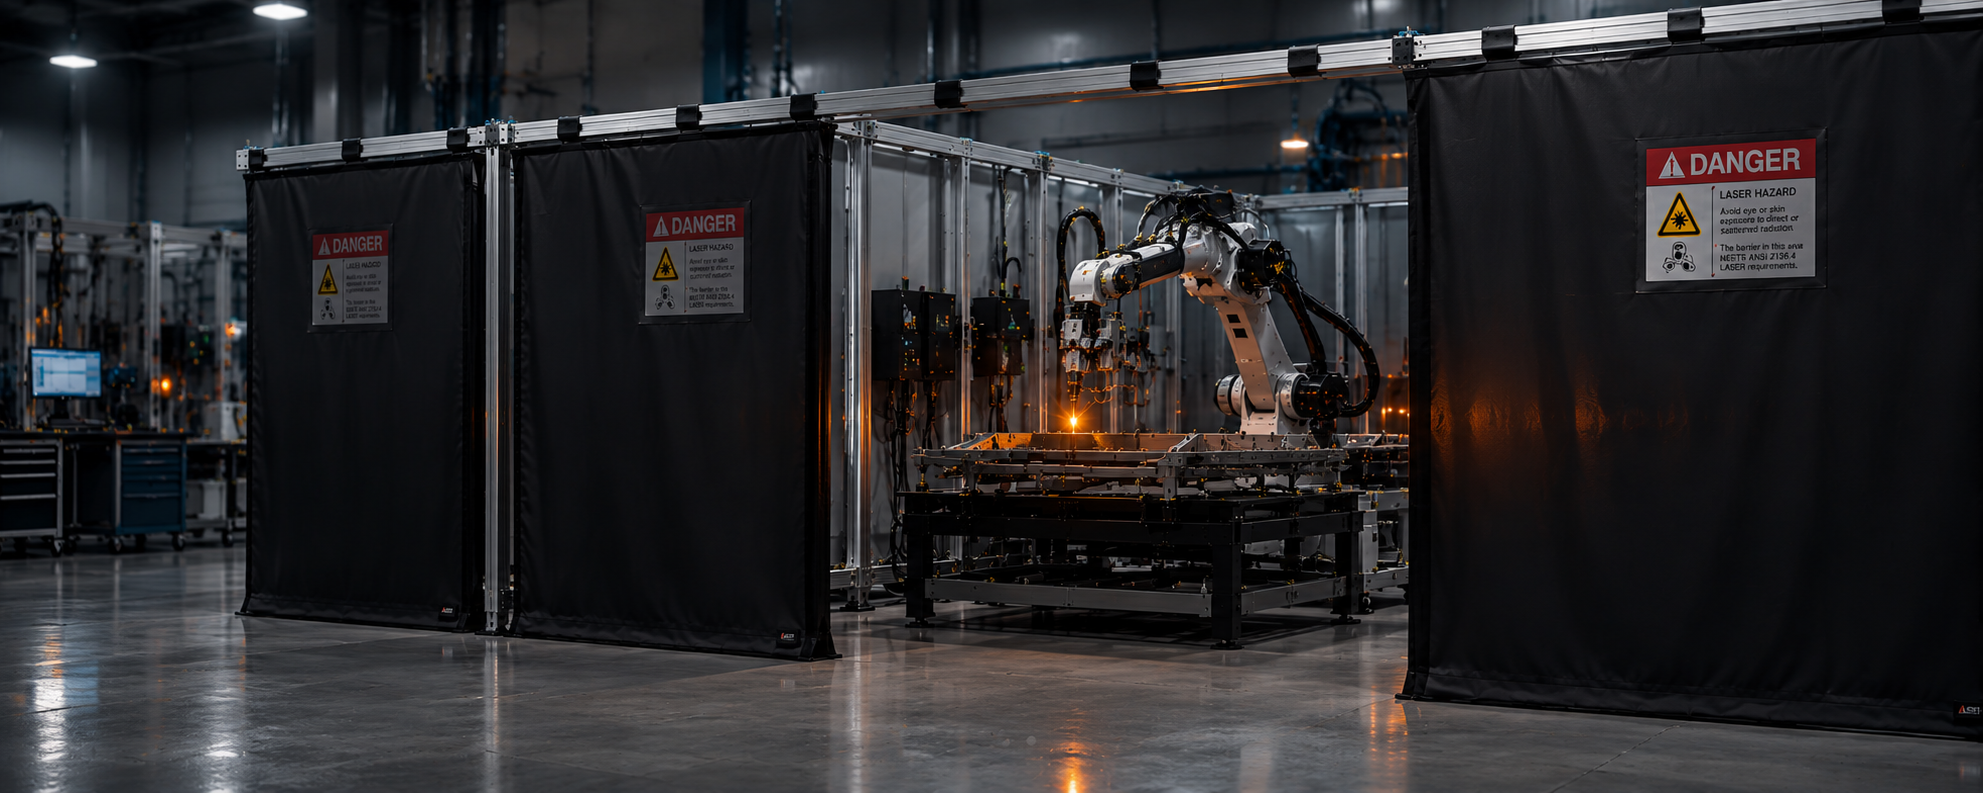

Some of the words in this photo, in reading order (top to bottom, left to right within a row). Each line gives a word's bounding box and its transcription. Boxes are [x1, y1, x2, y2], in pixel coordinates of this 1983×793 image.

[1690, 148, 1801, 176] DANGER
[1719, 189, 1752, 200] LASER
[1754, 187, 1797, 198] HAZARD
[671, 213, 736, 235] DANGER
[332, 235, 383, 254] DANGER
[1720, 243, 1734, 251] The
[1748, 252, 1768, 261] ANSI
[1719, 263, 1745, 271] LASER
